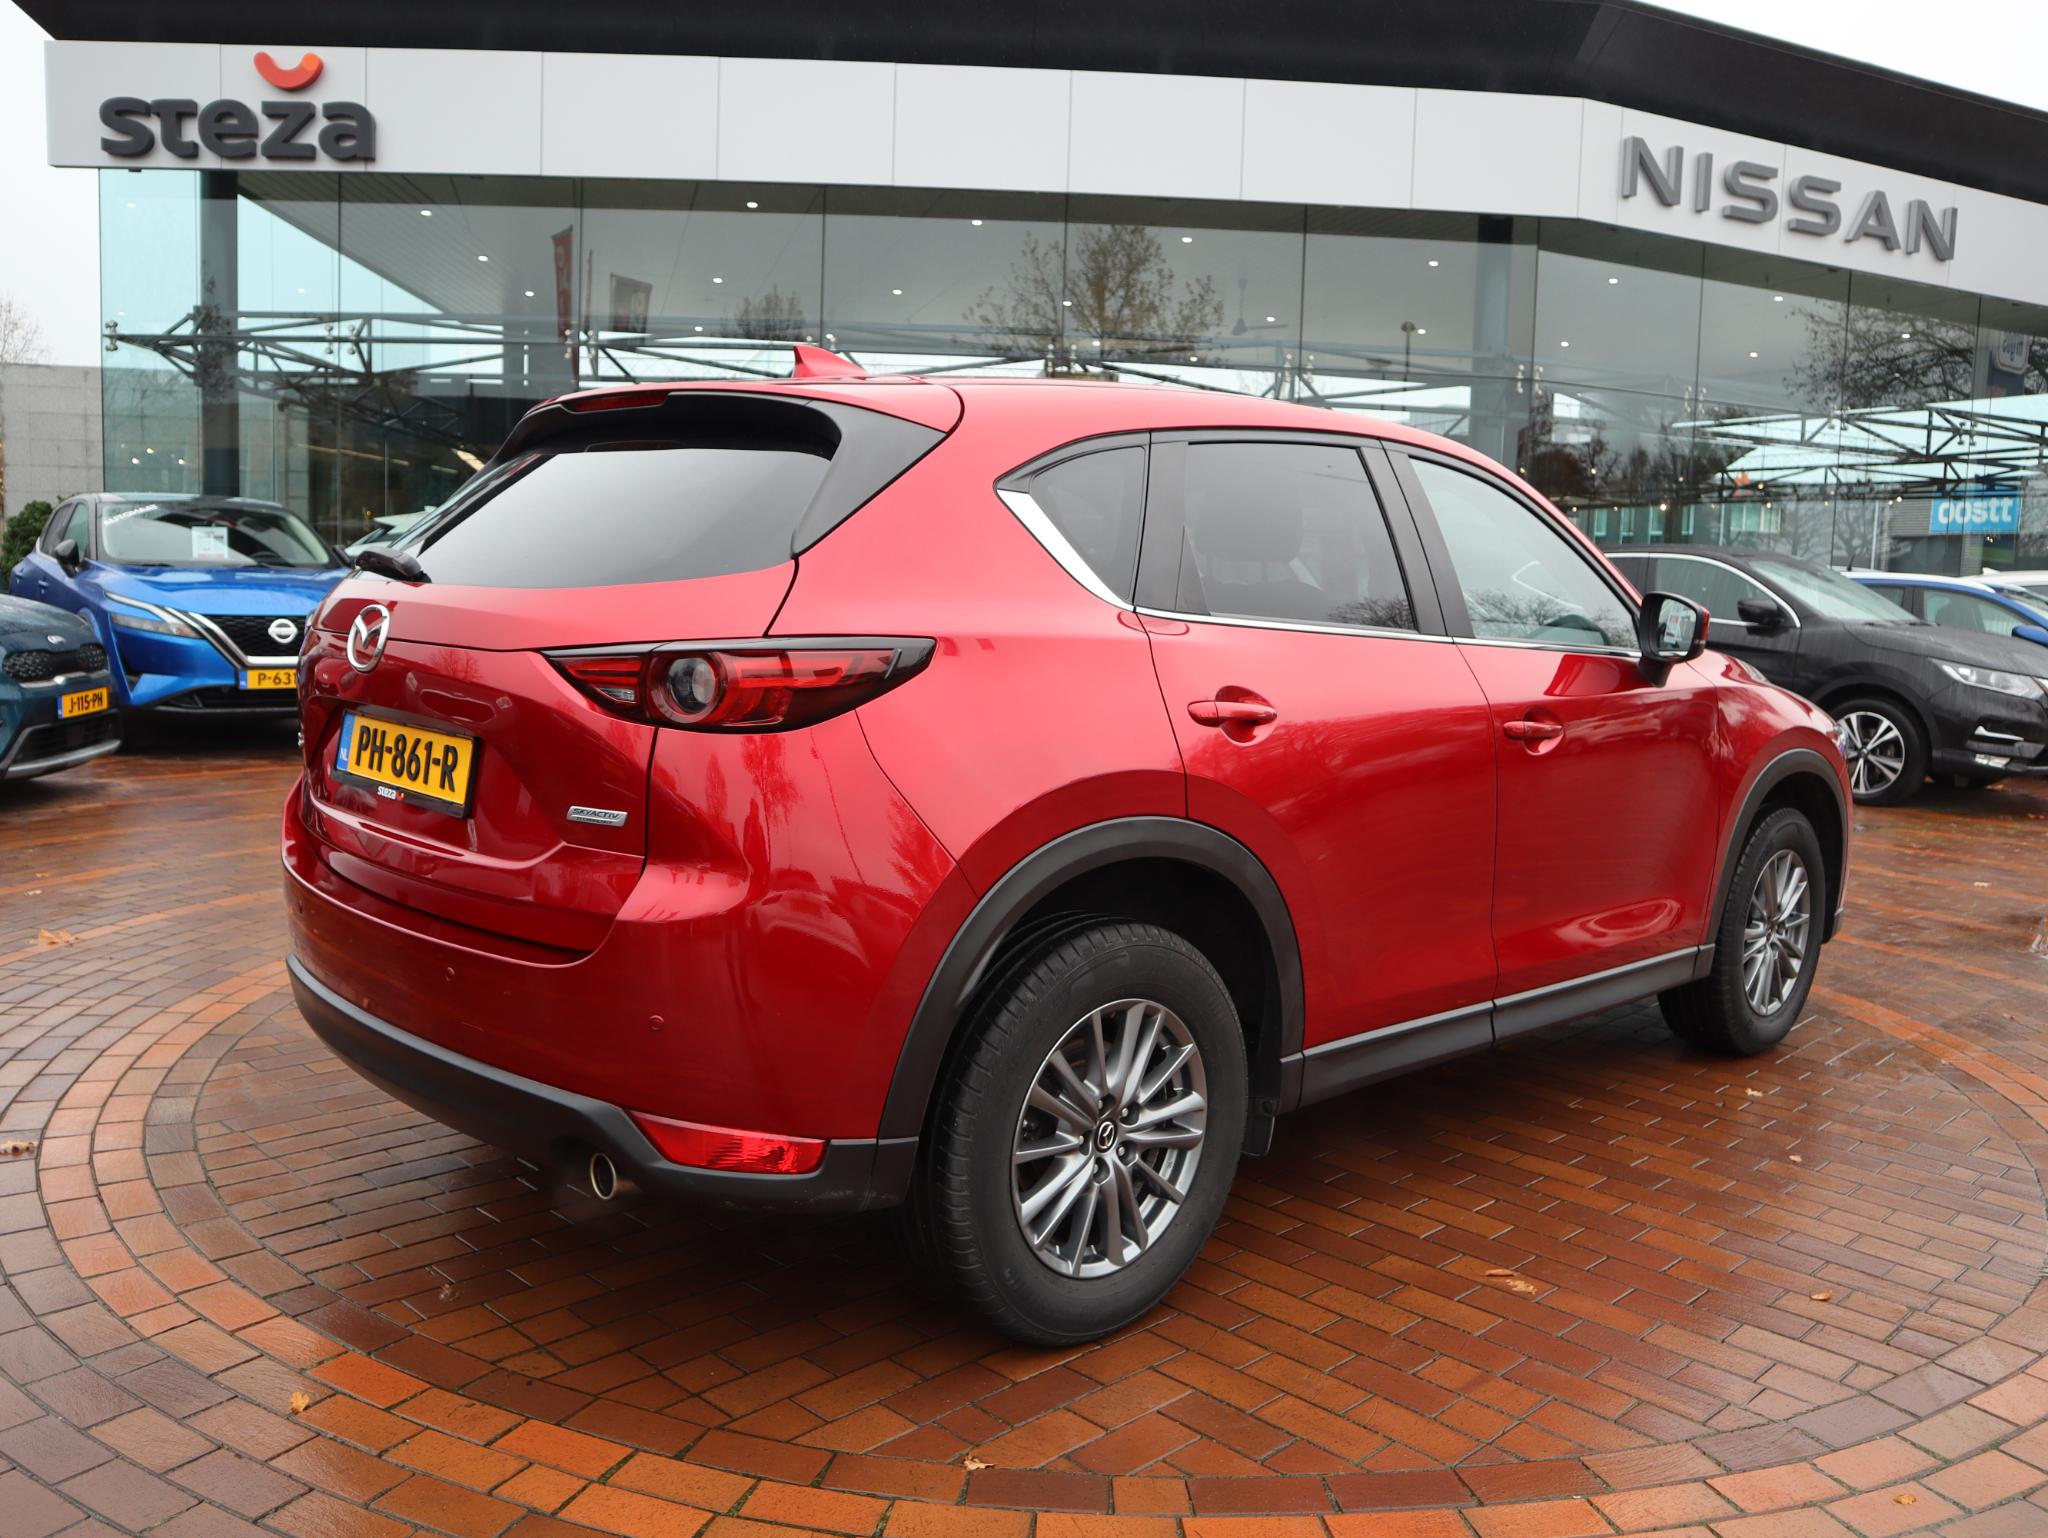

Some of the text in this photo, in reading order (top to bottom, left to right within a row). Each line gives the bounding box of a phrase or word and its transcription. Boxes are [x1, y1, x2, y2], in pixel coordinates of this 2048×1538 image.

[99, 96, 376, 162] steza
[1621, 135, 1959, 263] NISSAN
[69, 690, 103, 713] J-115-PH
[340, 747, 348, 761] NL
[355, 725, 458, 792] PH-861-R
[572, 808, 620, 819] SKYACTIV
